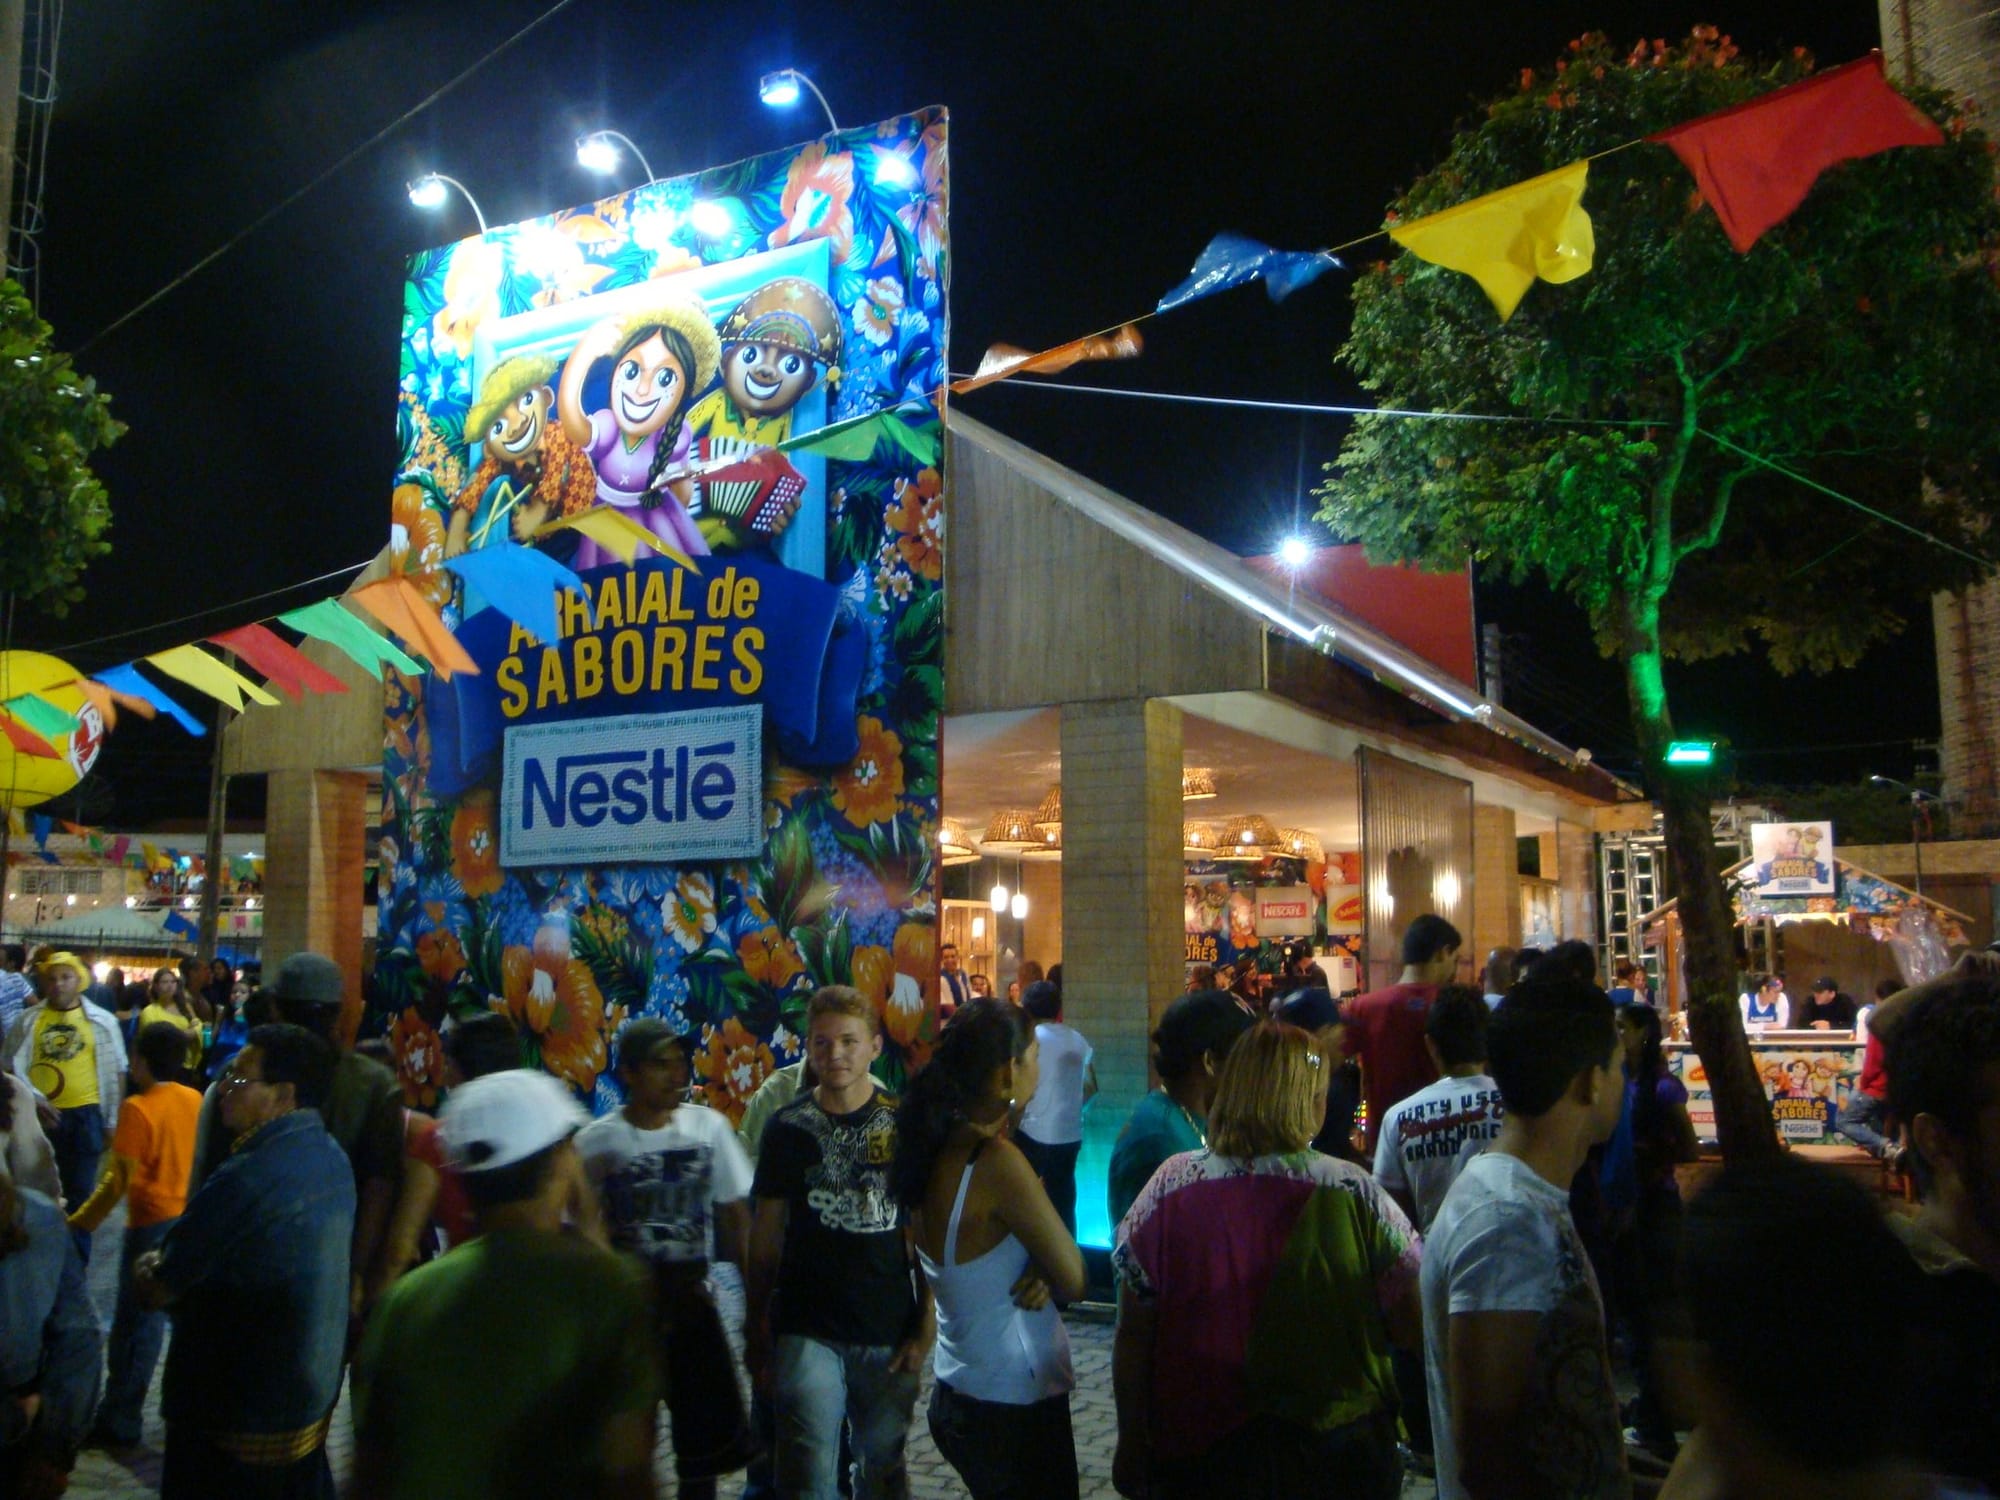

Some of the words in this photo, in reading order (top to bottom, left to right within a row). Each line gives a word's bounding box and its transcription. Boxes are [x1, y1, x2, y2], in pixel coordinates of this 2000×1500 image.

[707, 566, 760, 619] de
[496, 625, 766, 719] SABORES
[521, 741, 737, 830] Nestlé
[1772, 1108, 1827, 1120] SABORES
